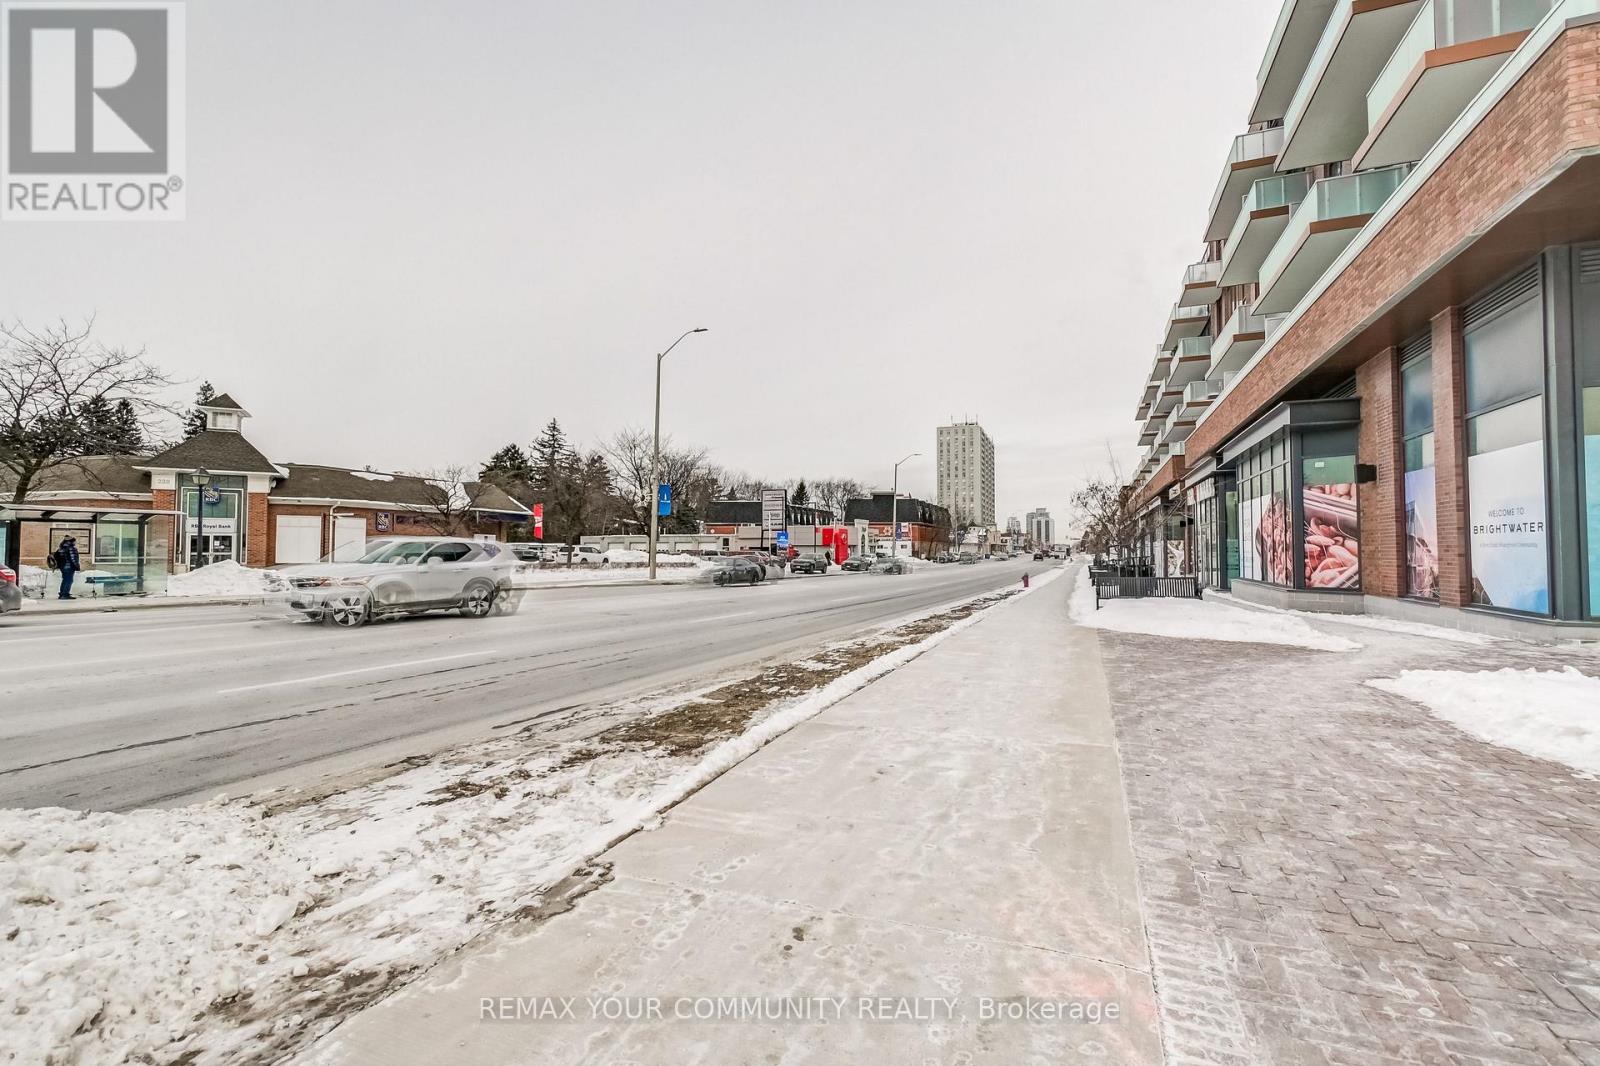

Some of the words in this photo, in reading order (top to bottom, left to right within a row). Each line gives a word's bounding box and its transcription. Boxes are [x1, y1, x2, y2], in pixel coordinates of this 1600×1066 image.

[1488, 507, 1515, 518] WELCOME
[1517, 506, 1525, 516] TO
[1473, 521, 1545, 535] BRIGHTWATER
